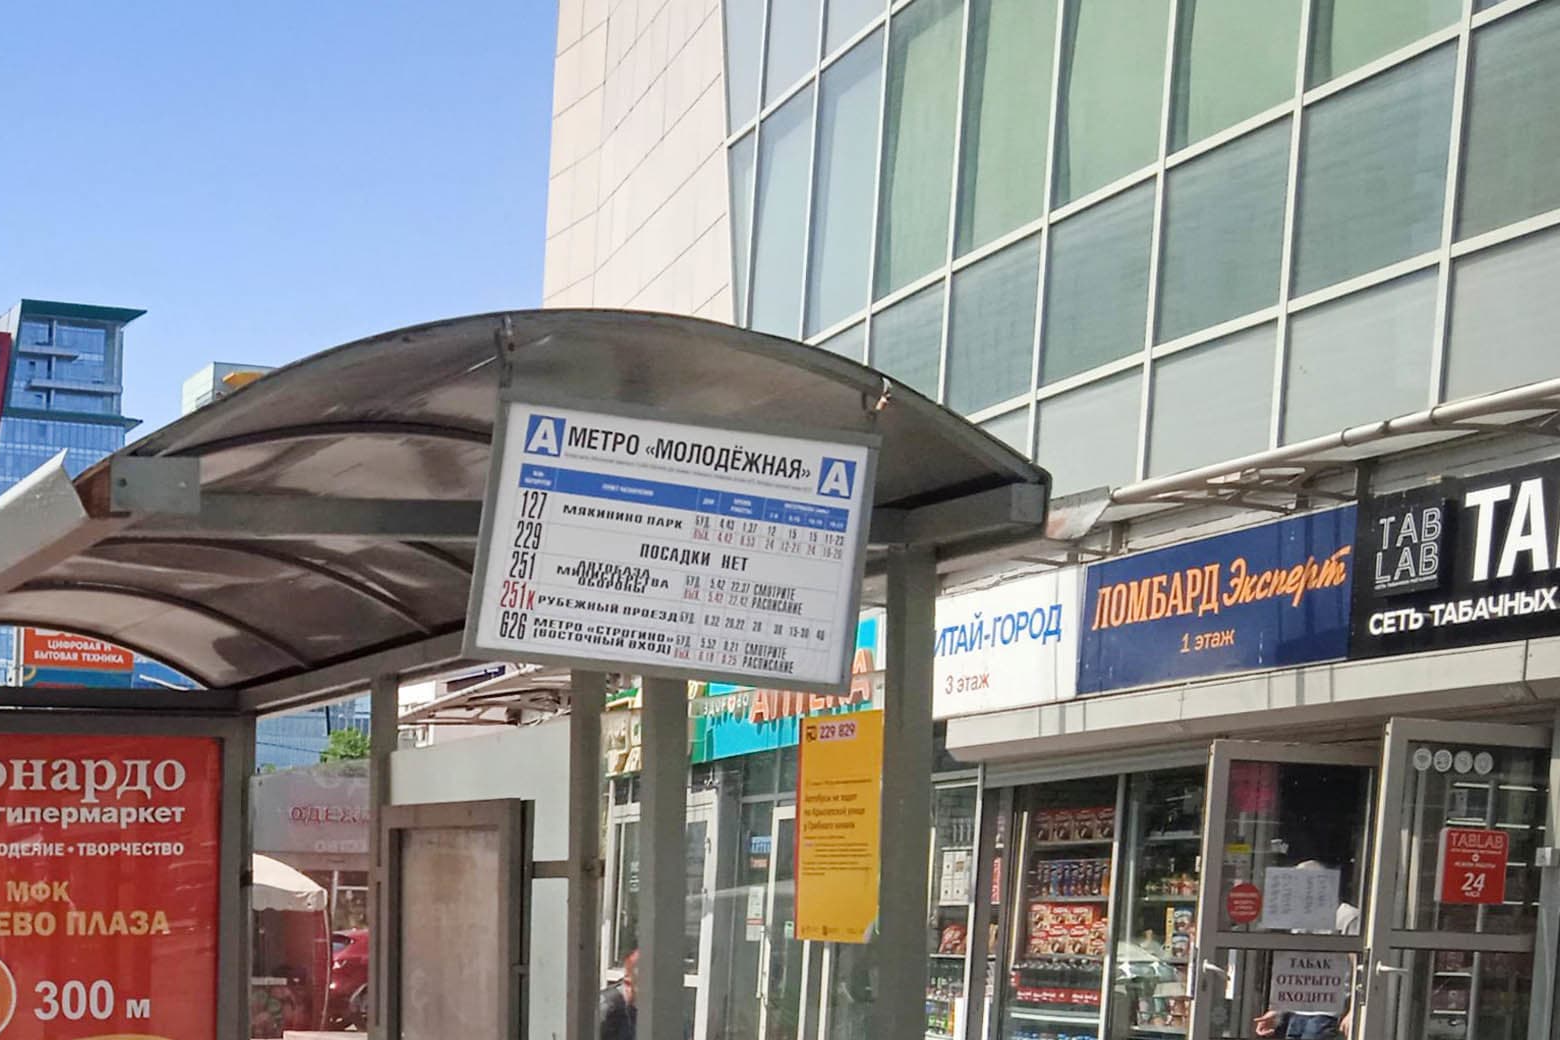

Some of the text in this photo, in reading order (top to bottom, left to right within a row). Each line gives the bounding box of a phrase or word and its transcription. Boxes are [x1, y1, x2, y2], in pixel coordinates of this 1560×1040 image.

[568, 426, 811, 480] МЕТРО «МОЛОДЁЖНАЯ»
[522, 490, 547, 519] 127
[563, 504, 683, 529] МЯКИНИНО ПАРК
[514, 520, 542, 549] 229
[1379, 507, 1441, 549] TAB
[1465, 477, 1560, 582] ТА
[509, 551, 536, 580] 251
[640, 543, 749, 571] ПОСАДКИ НЕТ
[1375, 542, 1439, 584] LAB
[753, 583, 796, 599] СМОТРИТЕ
[1091, 545, 1352, 631] ЛОМБАРД Эксперт
[538, 595, 678, 623] РУБЕЖНЫЙ ПРОЕЗД
[751, 597, 803, 615] РАСПИСАНИЕ
[1369, 587, 1558, 635] СЕТЬ ТАБАЧНЫХ
[500, 611, 527, 640] 626
[533, 617, 674, 643] МЕТРО «СТРОГИНО»
[934, 604, 1062, 658] ИТАЙ-ГОРОД
[48, 640, 101, 651] ЦИФРОВАЯ
[744, 642, 787, 660] СМОТРИТЕ
[1180, 629, 1236, 653] 1 этаж
[34, 651, 78, 661] БЫТОВАЯ
[82, 652, 124, 664] ТЕХНИКА
[742, 656, 794, 674] РАСПИСАНИЕ
[945, 673, 990, 694] 3 этаж
[820, 724, 836, 739] 229
[77, 842, 184, 857] ТВОРЧЕСТВО
[1451, 833, 1503, 849] TABLAB
[6, 880, 71, 902] МФК
[1461, 872, 1486, 891] 24
[66, 911, 171, 937] ПЛАЗА
[1290, 958, 1331, 969] ТАБАК
[1276, 974, 1341, 986] ОТКРЫТО
[33, 978, 151, 1020] 300 м
[1278, 991, 1335, 1003] ВХОДИТЕ
